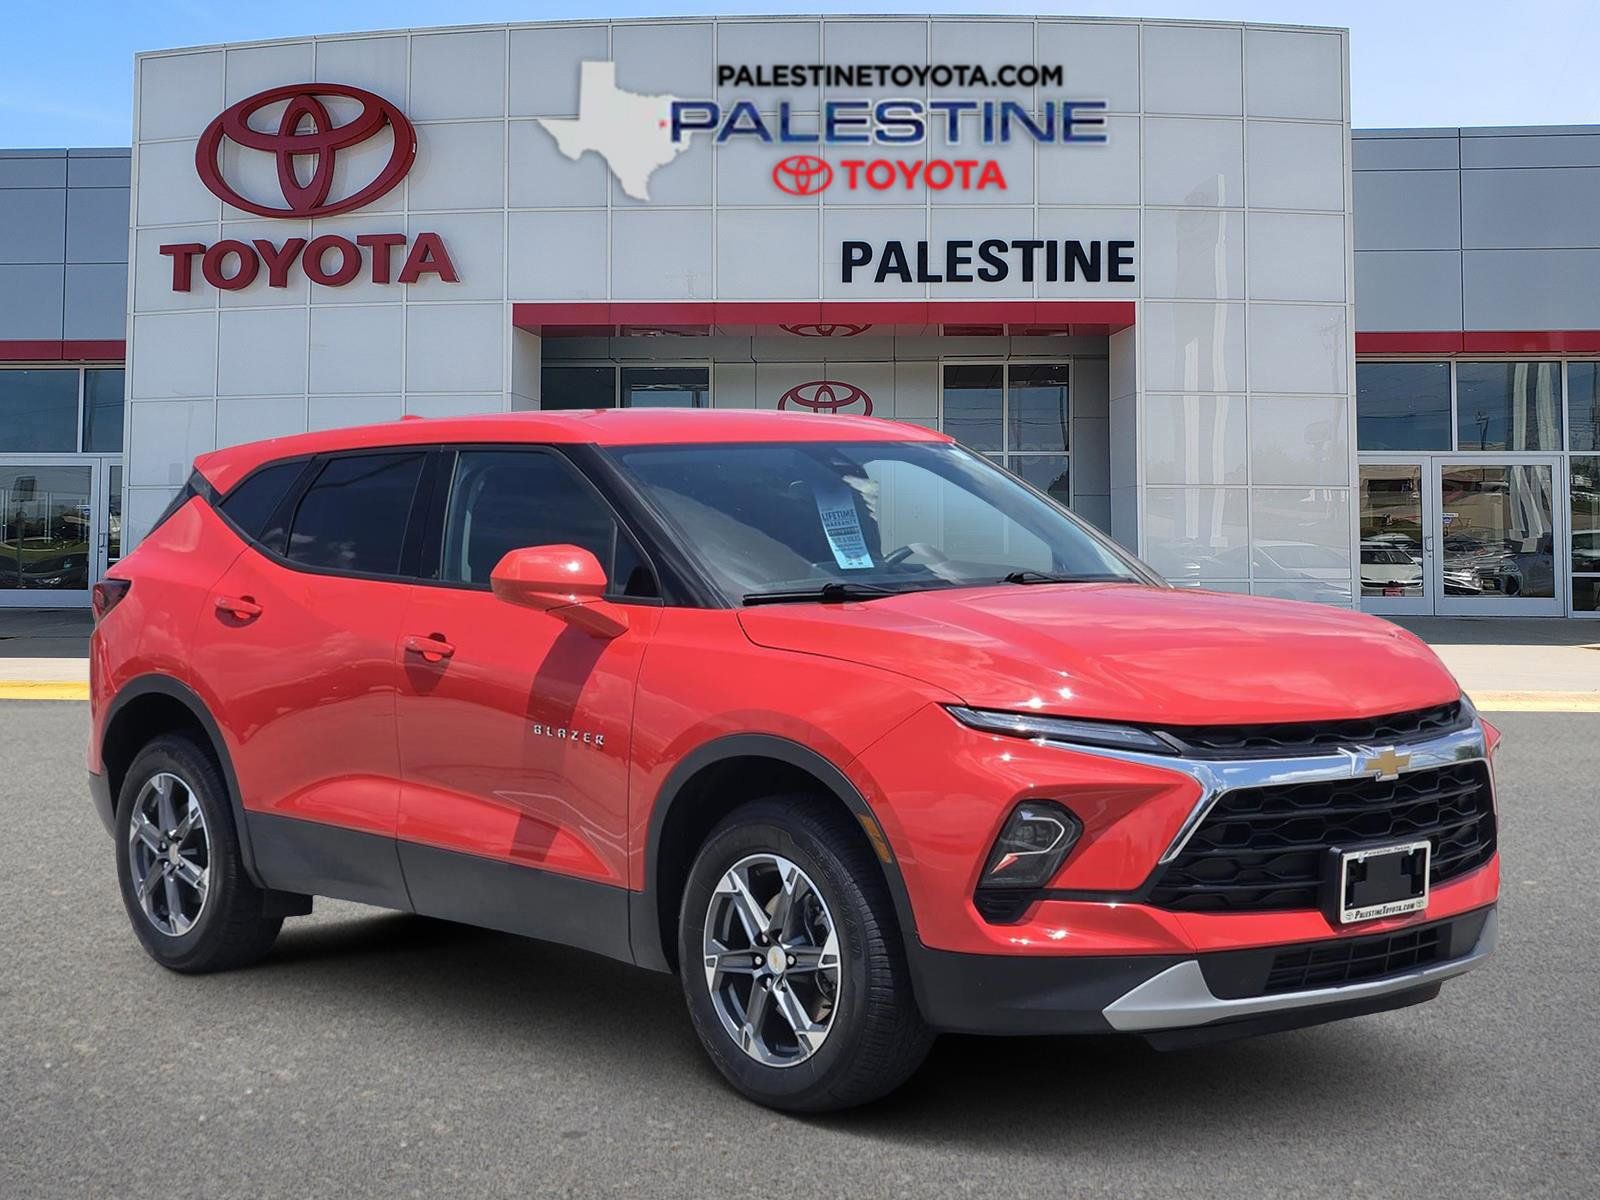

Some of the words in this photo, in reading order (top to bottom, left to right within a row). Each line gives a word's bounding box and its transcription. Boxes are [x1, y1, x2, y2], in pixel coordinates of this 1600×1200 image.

[159, 231, 461, 293] TOYOTA
[841, 240, 1136, 284] PALESTINE
[533, 724, 605, 746] BLAZER
